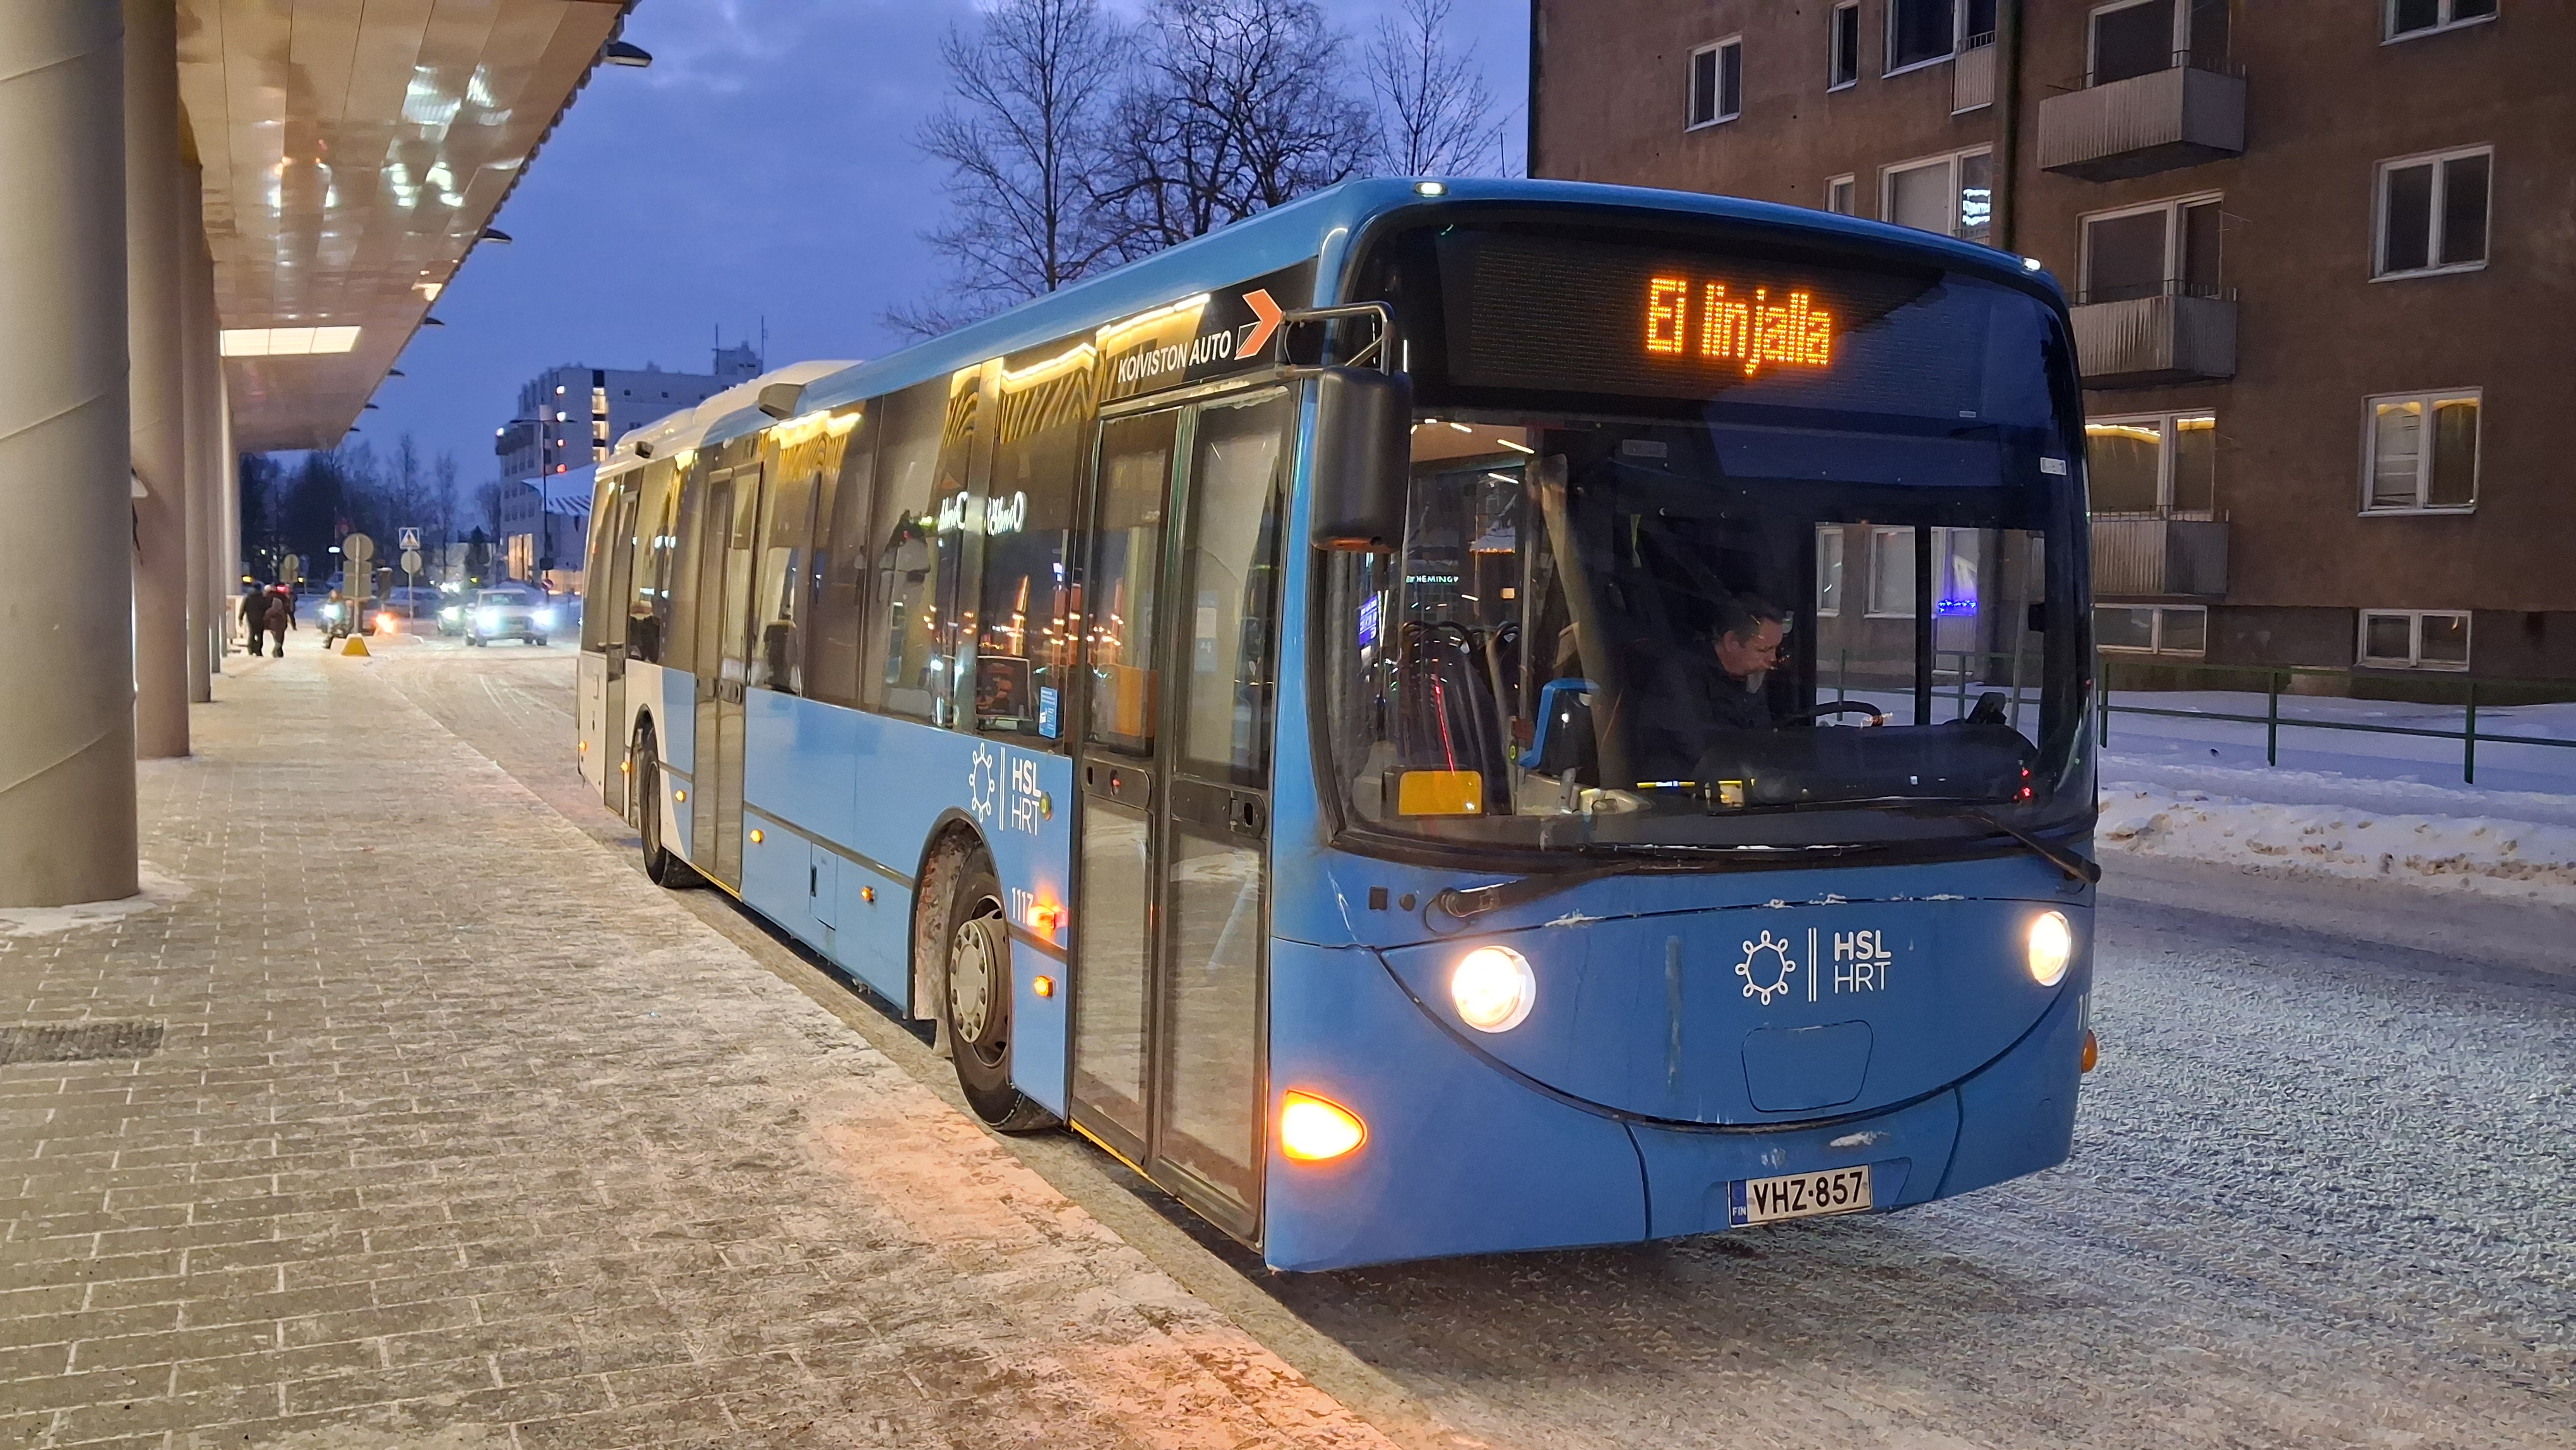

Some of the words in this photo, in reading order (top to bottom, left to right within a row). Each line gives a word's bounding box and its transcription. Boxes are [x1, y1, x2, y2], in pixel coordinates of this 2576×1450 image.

[1647, 278, 1687, 353] Ei
[1701, 283, 1832, 375] linjalla
[1117, 342, 1188, 383] KOIVISTON
[1189, 330, 1231, 366] AUTO
[1011, 757, 1042, 798] HSL
[1011, 794, 1040, 836] HRT
[1834, 930, 1892, 961] HSL
[1834, 961, 1892, 994] HRT
[1732, 1206, 1747, 1216] FIN
[1753, 1170, 1863, 1216] VHZ-857
